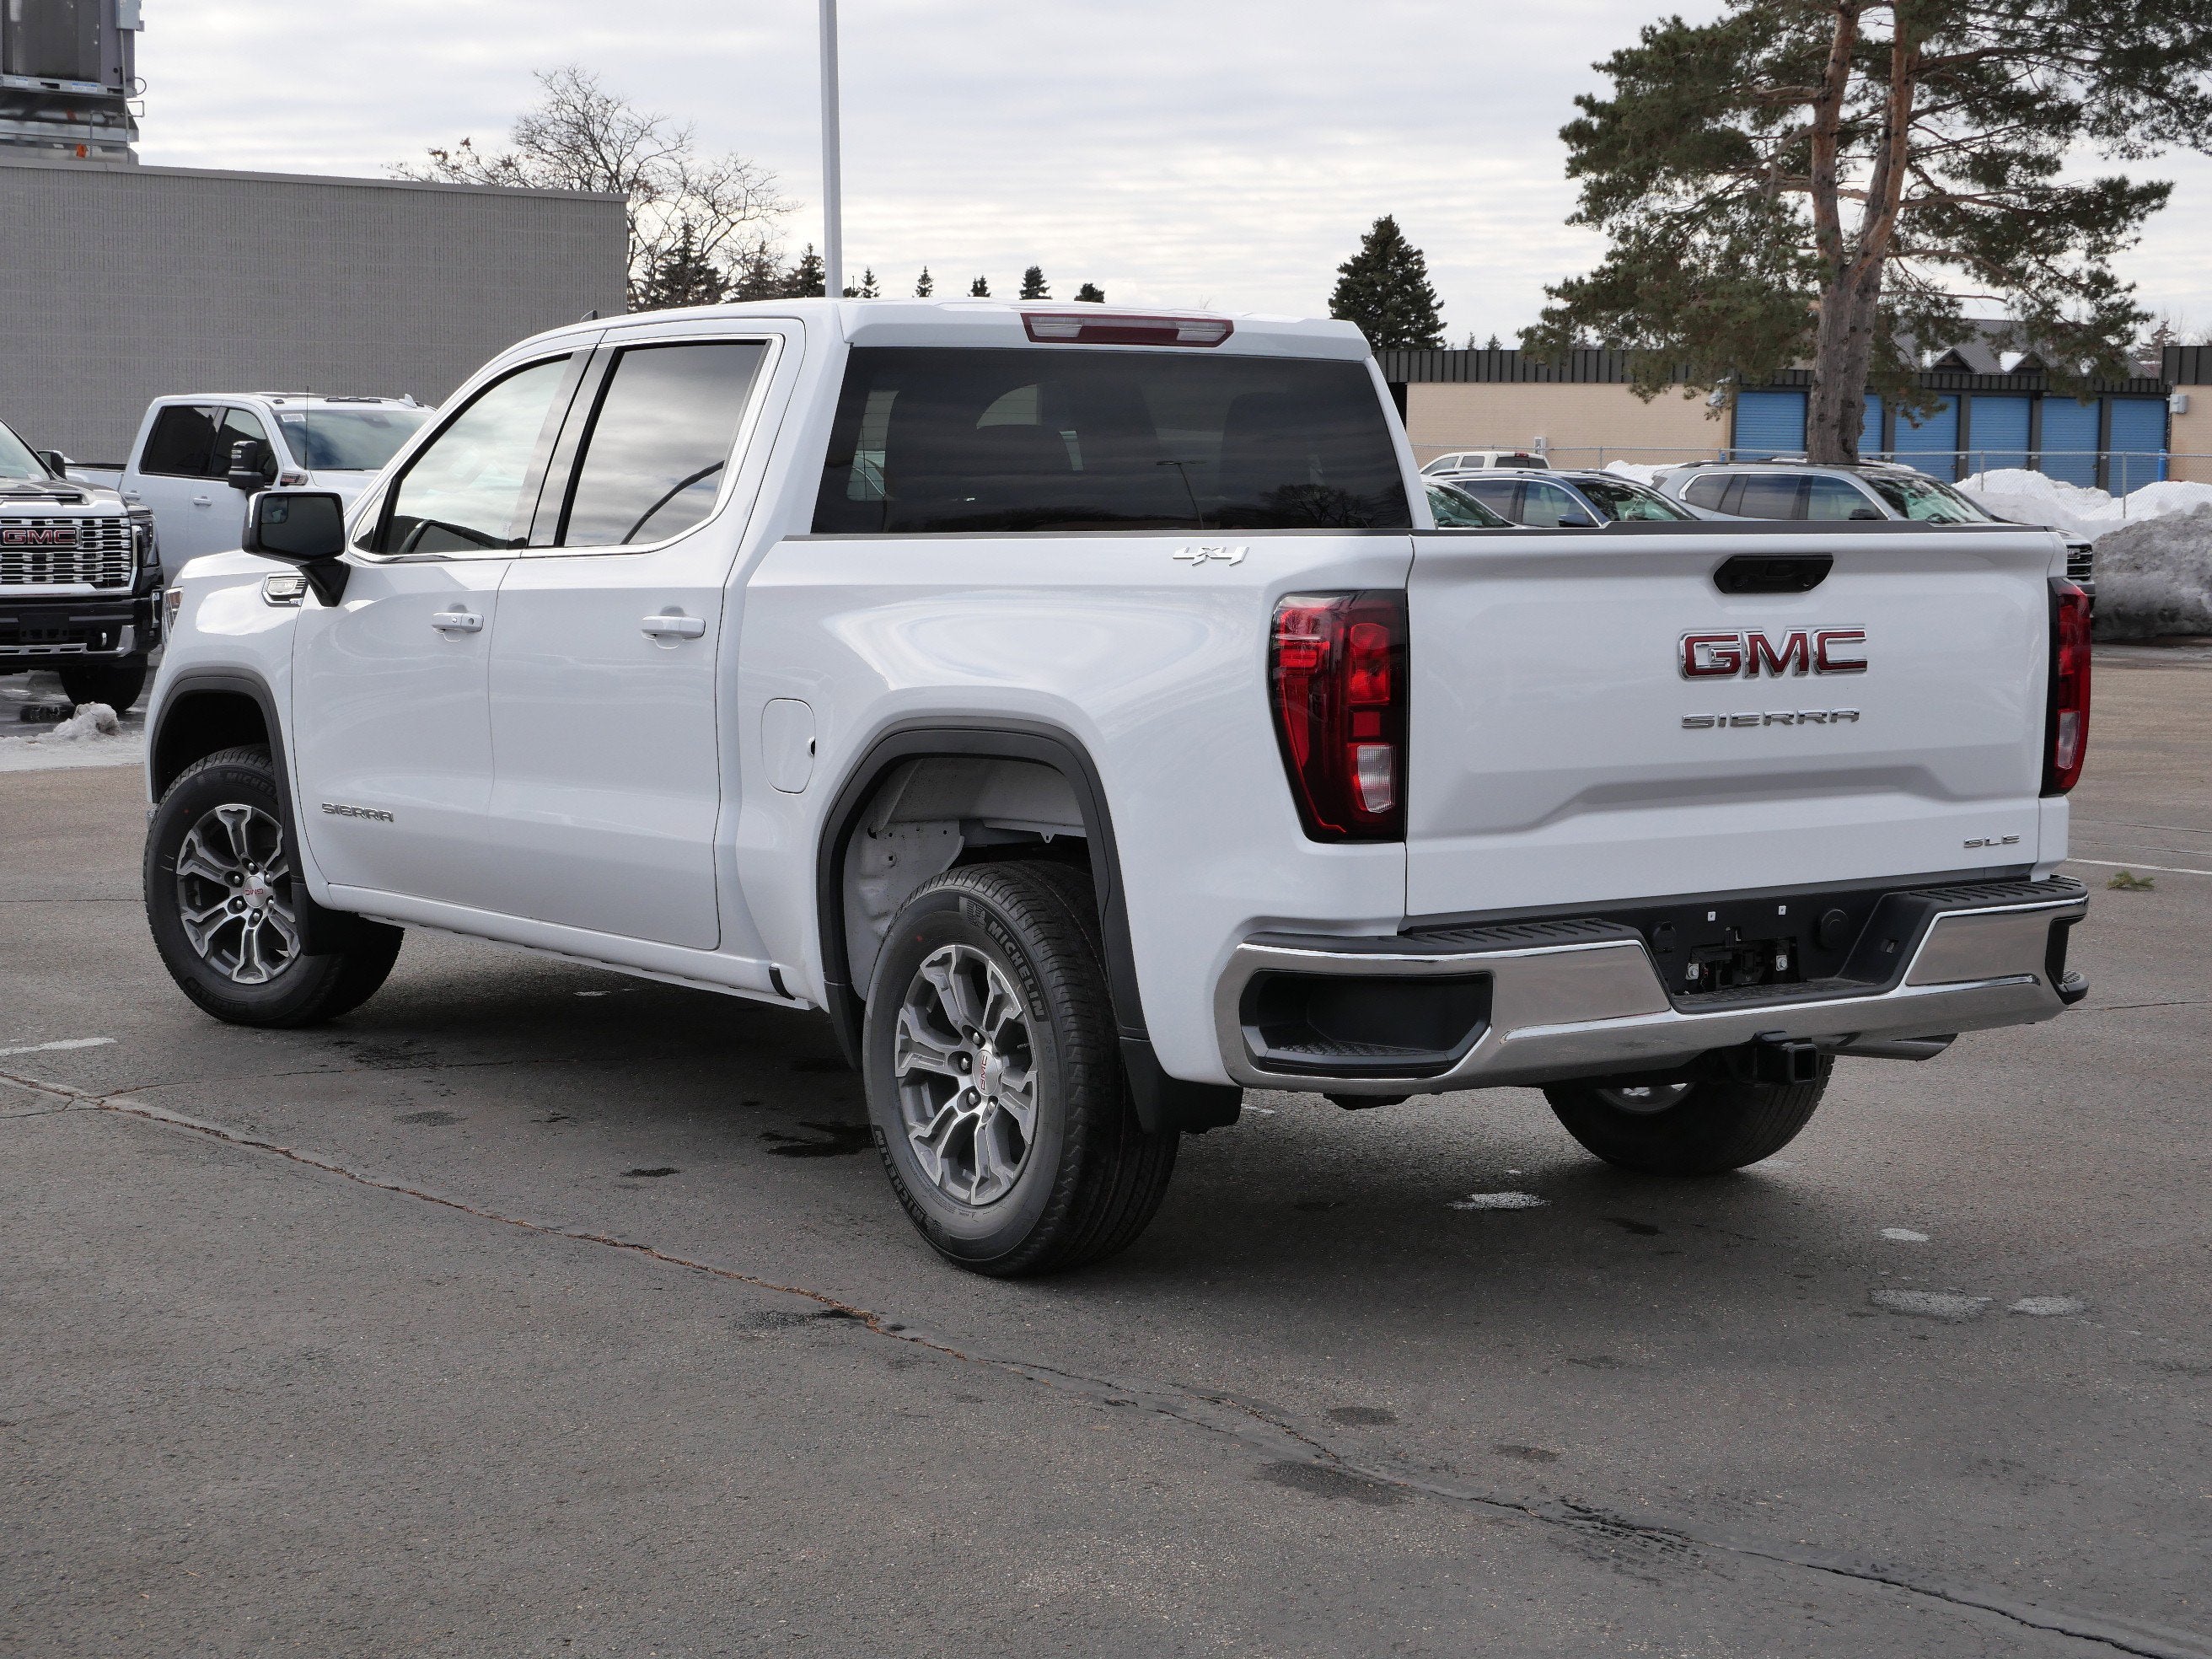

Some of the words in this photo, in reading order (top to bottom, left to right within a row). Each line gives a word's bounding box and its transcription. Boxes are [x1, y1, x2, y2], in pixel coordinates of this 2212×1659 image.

[3, 529, 76, 545] GMC
[1679, 627, 1868, 680] GMC
[1681, 708, 1860, 729] SIERRA
[321, 803, 394, 822] SIERRA
[1963, 834, 2021, 848] SLE
[987, 921, 1044, 1016] MICHELIN
[874, 1130, 925, 1222] MICHELIN
